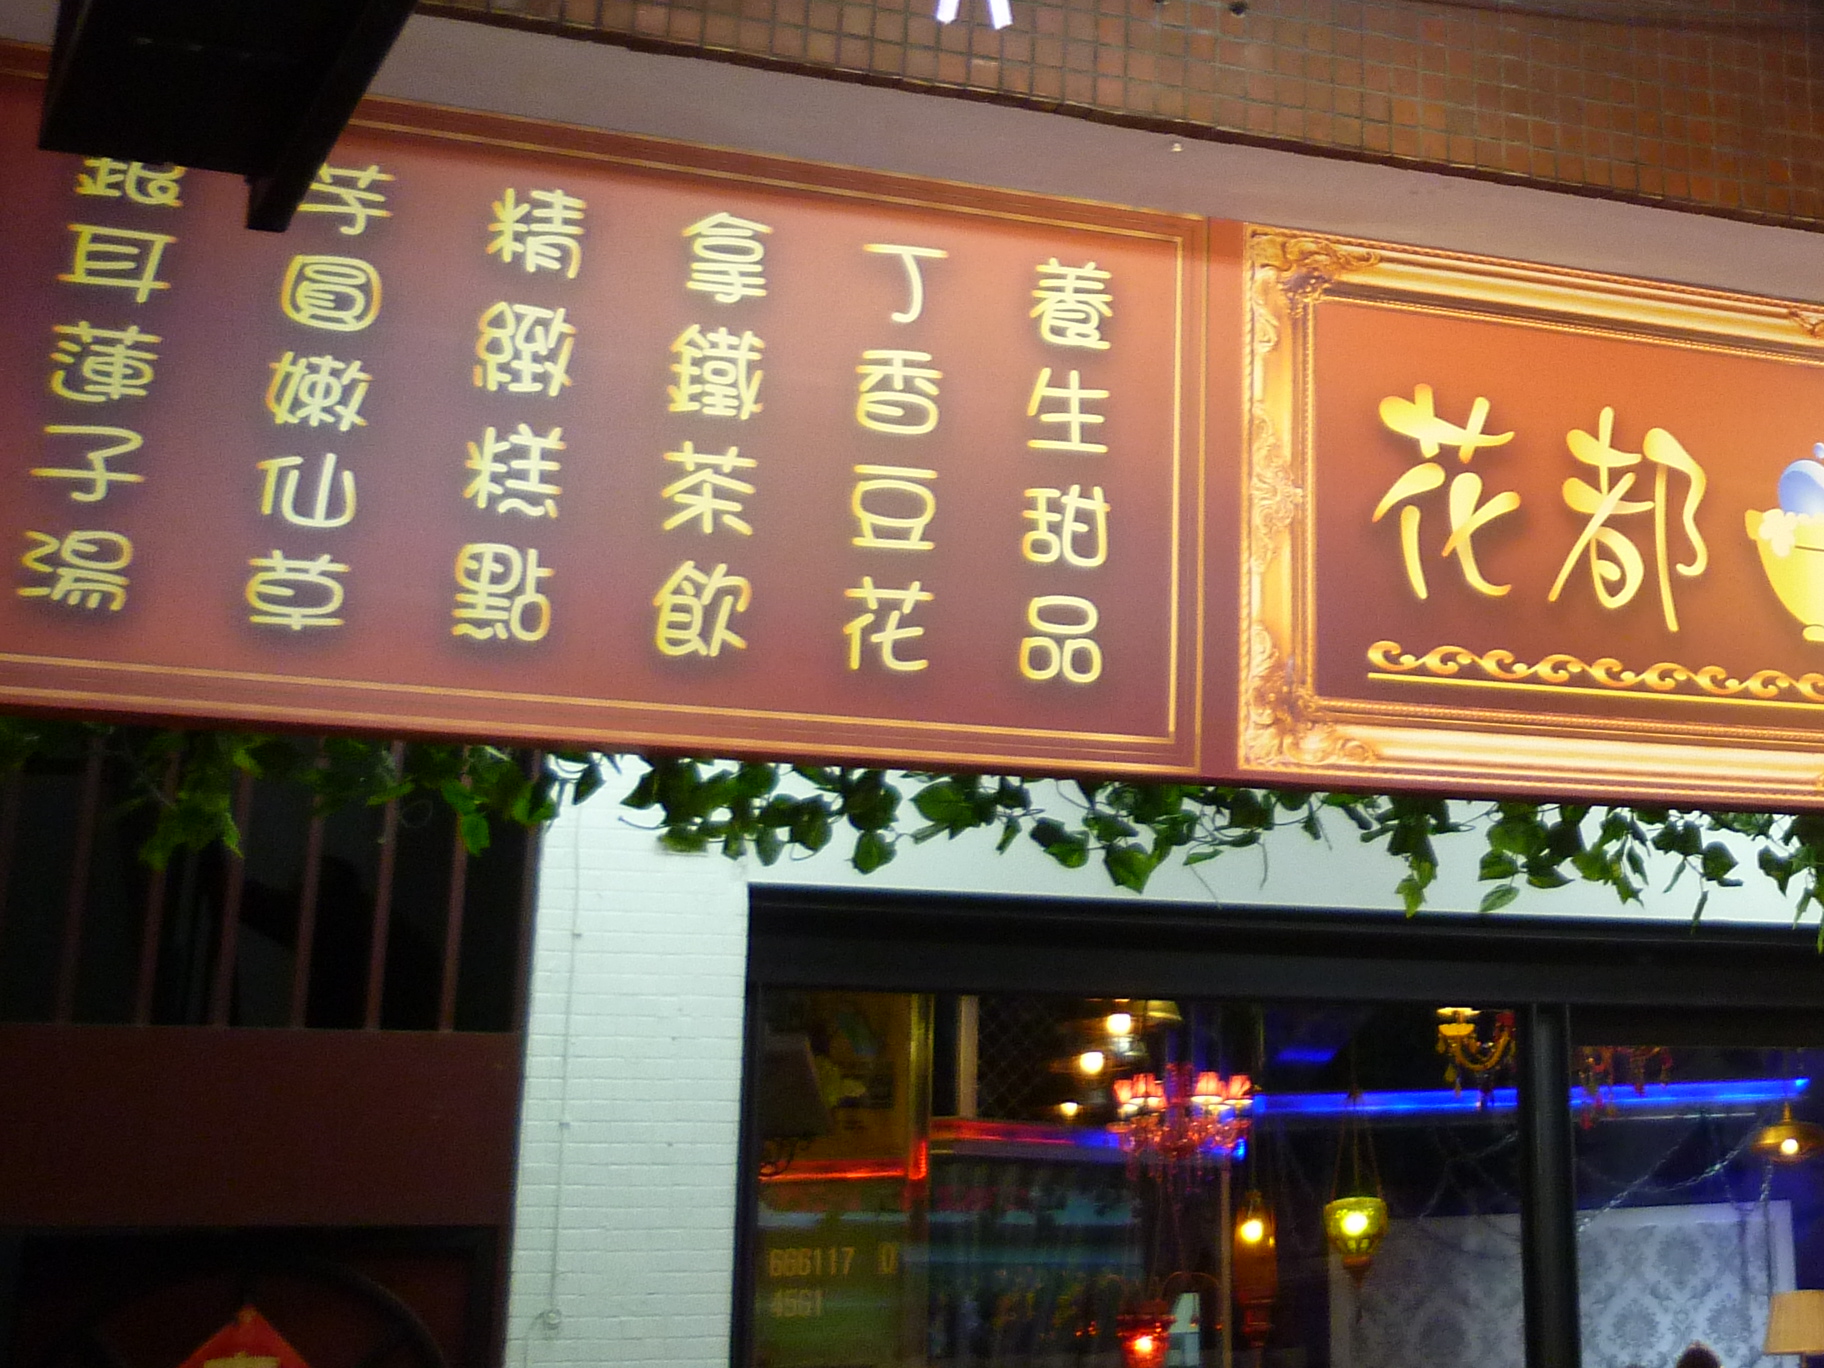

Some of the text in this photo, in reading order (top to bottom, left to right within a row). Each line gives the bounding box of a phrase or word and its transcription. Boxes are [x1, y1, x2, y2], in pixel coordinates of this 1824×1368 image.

[246, 164, 396, 631] 芋圓嫩仙草
[452, 187, 588, 642] 精緻糕點
[652, 212, 774, 658] 拿鐵茶飲
[843, 243, 949, 671] 丁香豆花
[1019, 257, 1113, 683] 養生甜品
[1371, 383, 1709, 633] 花都
